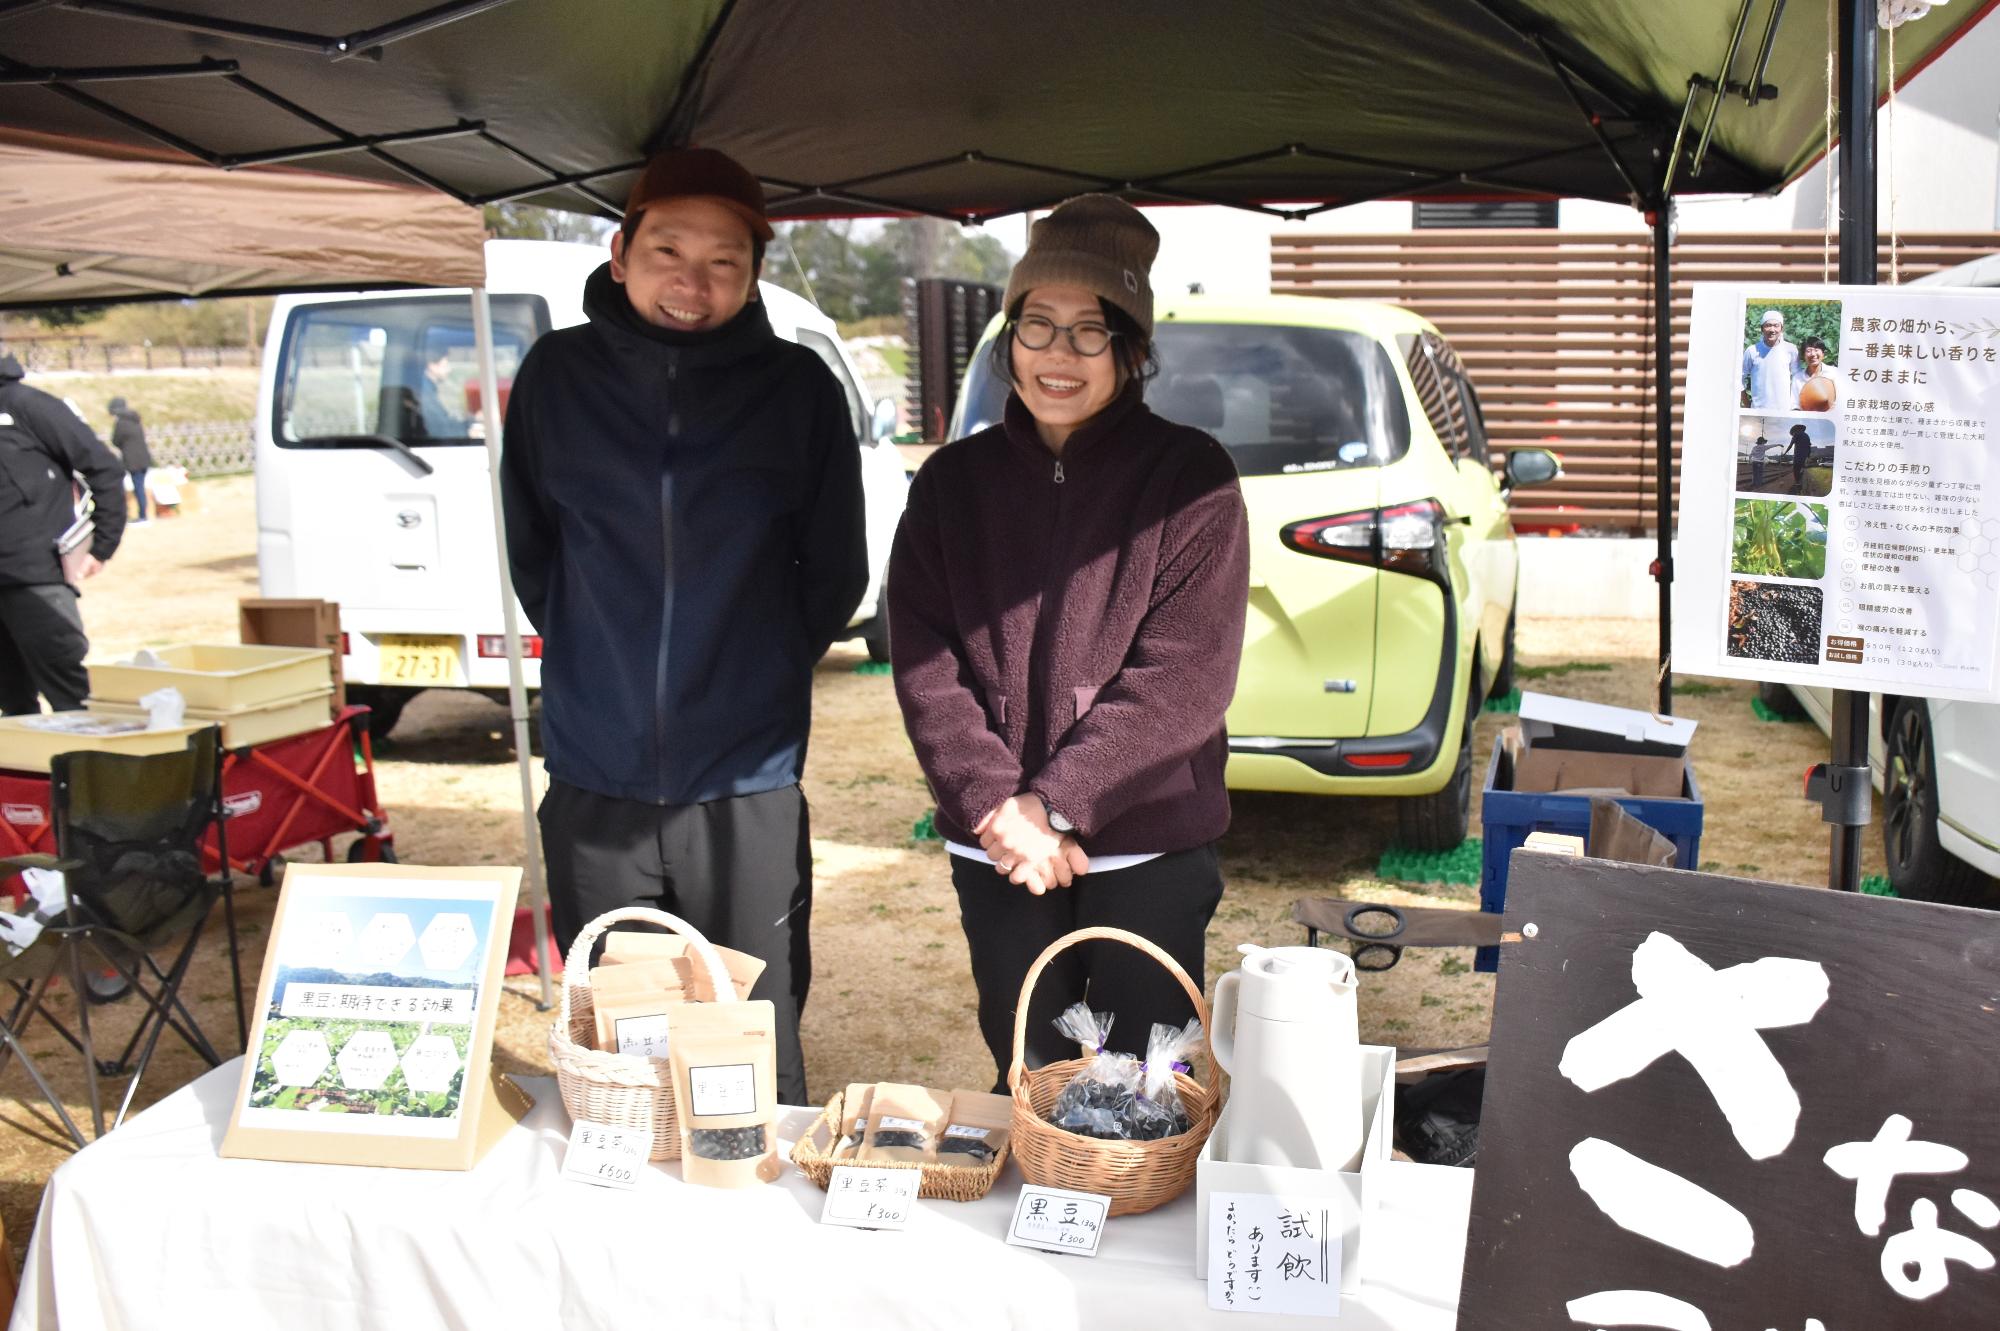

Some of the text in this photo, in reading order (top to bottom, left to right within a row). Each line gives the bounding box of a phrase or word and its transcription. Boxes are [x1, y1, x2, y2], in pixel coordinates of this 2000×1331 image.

[1850, 317, 1955, 335] 農家の畑から、
[1848, 343, 1998, 362] 一番美味しい香りを
[1848, 368, 1928, 385] そのままに
[1846, 398, 1936, 413] 自家栽培の安心感
[1844, 461, 1931, 475] こだわりの手煎り
[1864, 520, 1960, 535] 冷え性・むくみの予防効果
[1861, 563, 1900, 574] 便秘の改善
[1860, 583, 1930, 595] お肌の調子を整える
[867, 1202, 900, 1220] ¥300
[1026, 1198, 1079, 1226] 黒豆
[1059, 1232, 1085, 1244] ¥300
[1276, 1208, 1316, 1281] 試飲
[1244, 1226, 1264, 1283] あります
